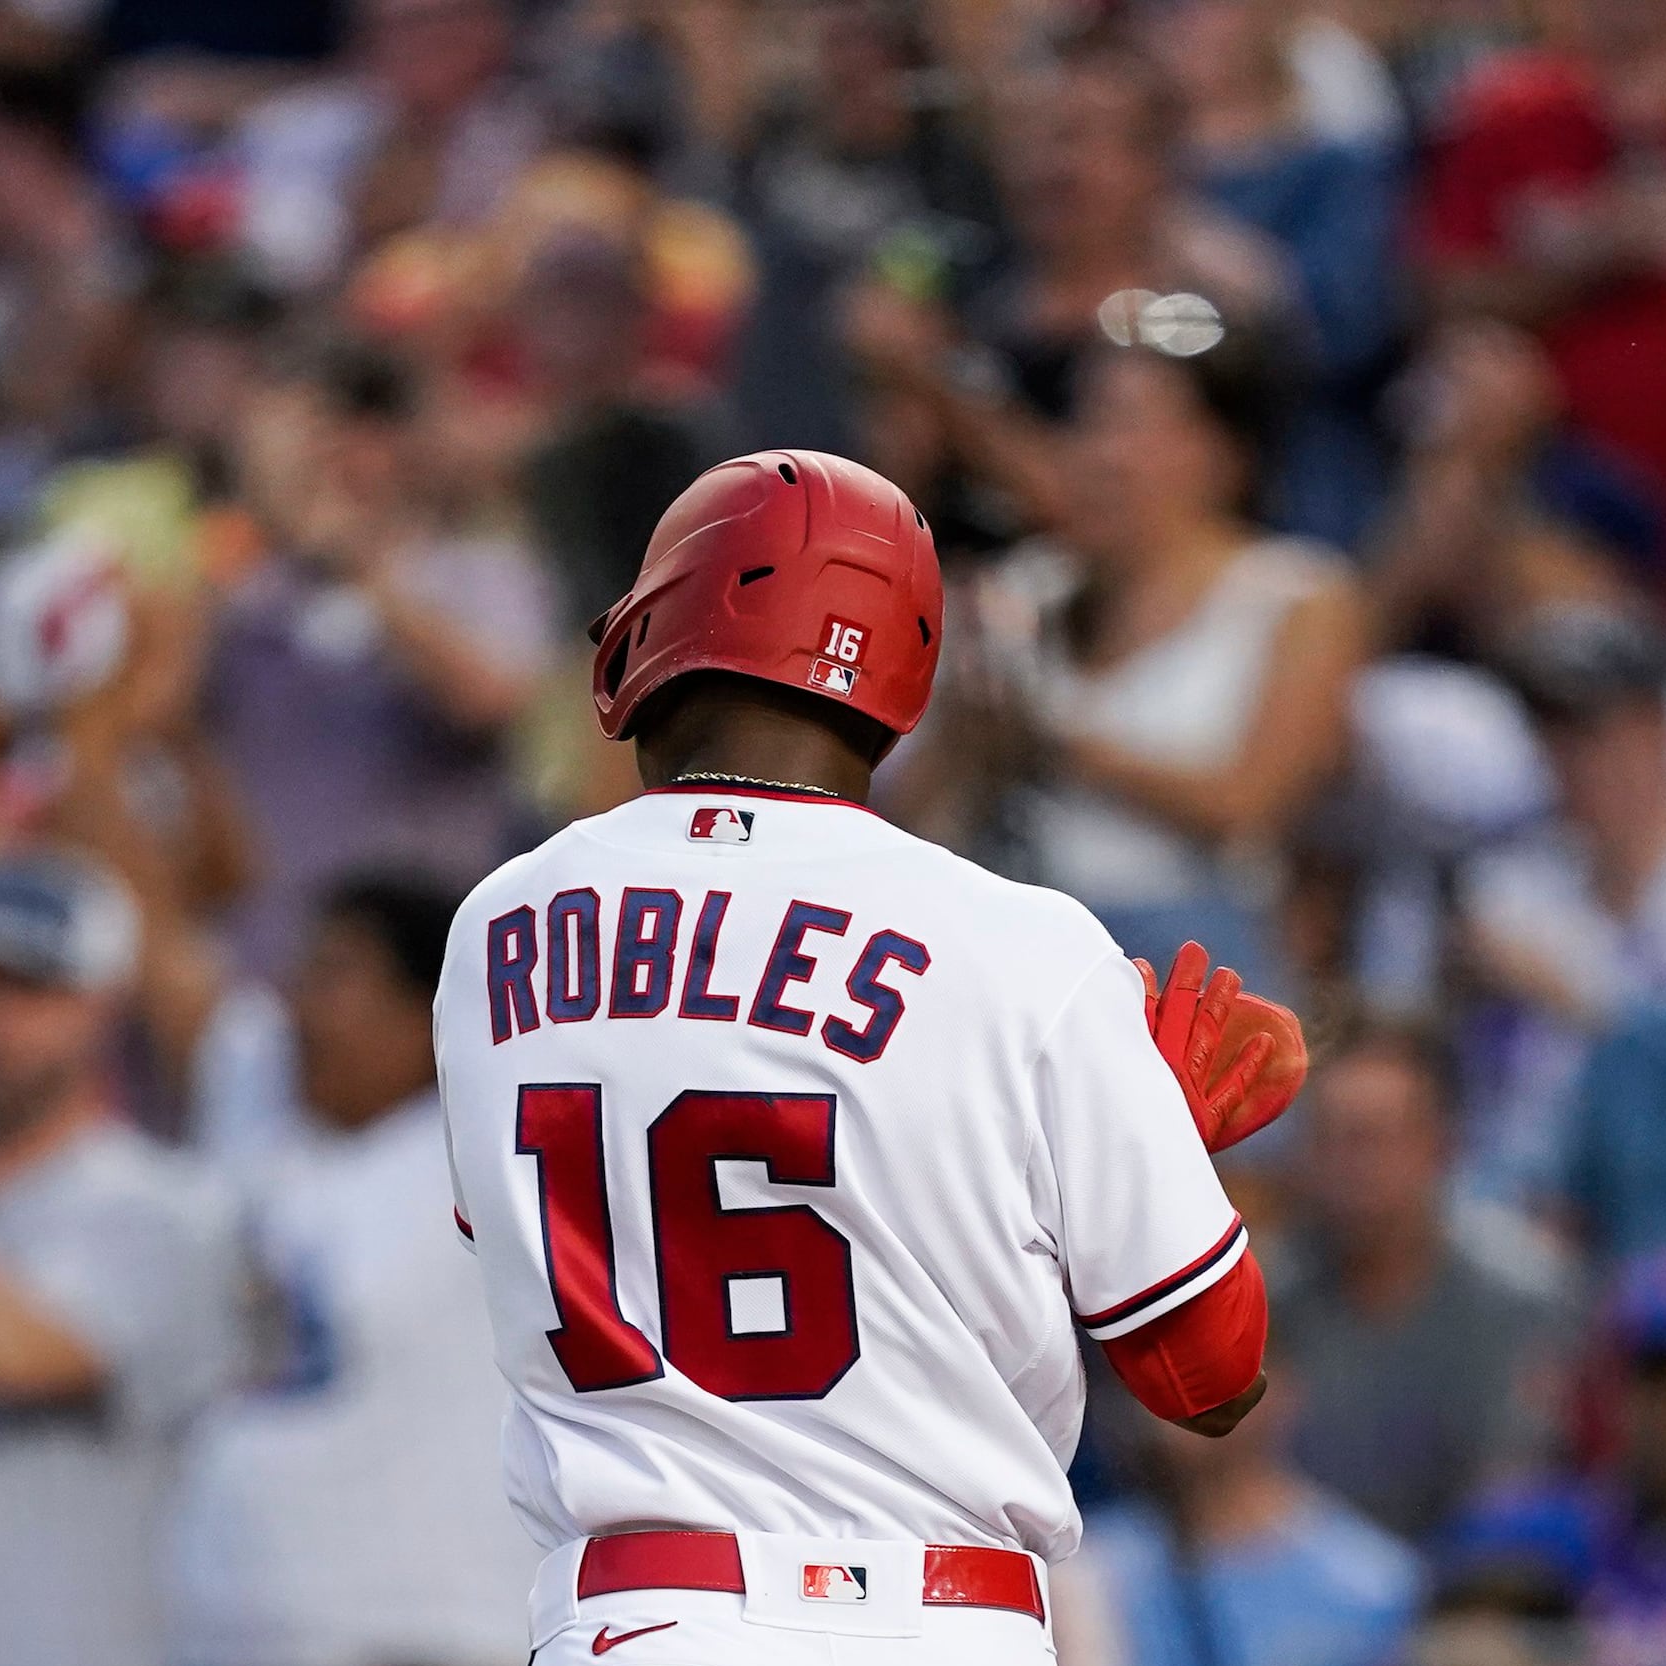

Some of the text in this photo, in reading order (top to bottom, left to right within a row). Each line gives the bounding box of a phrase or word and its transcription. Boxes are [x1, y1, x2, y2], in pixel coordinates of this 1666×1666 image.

[824, 621, 864, 663] 16
[486, 886, 931, 1064] ROBLES
[515, 1082, 861, 1402] 16
